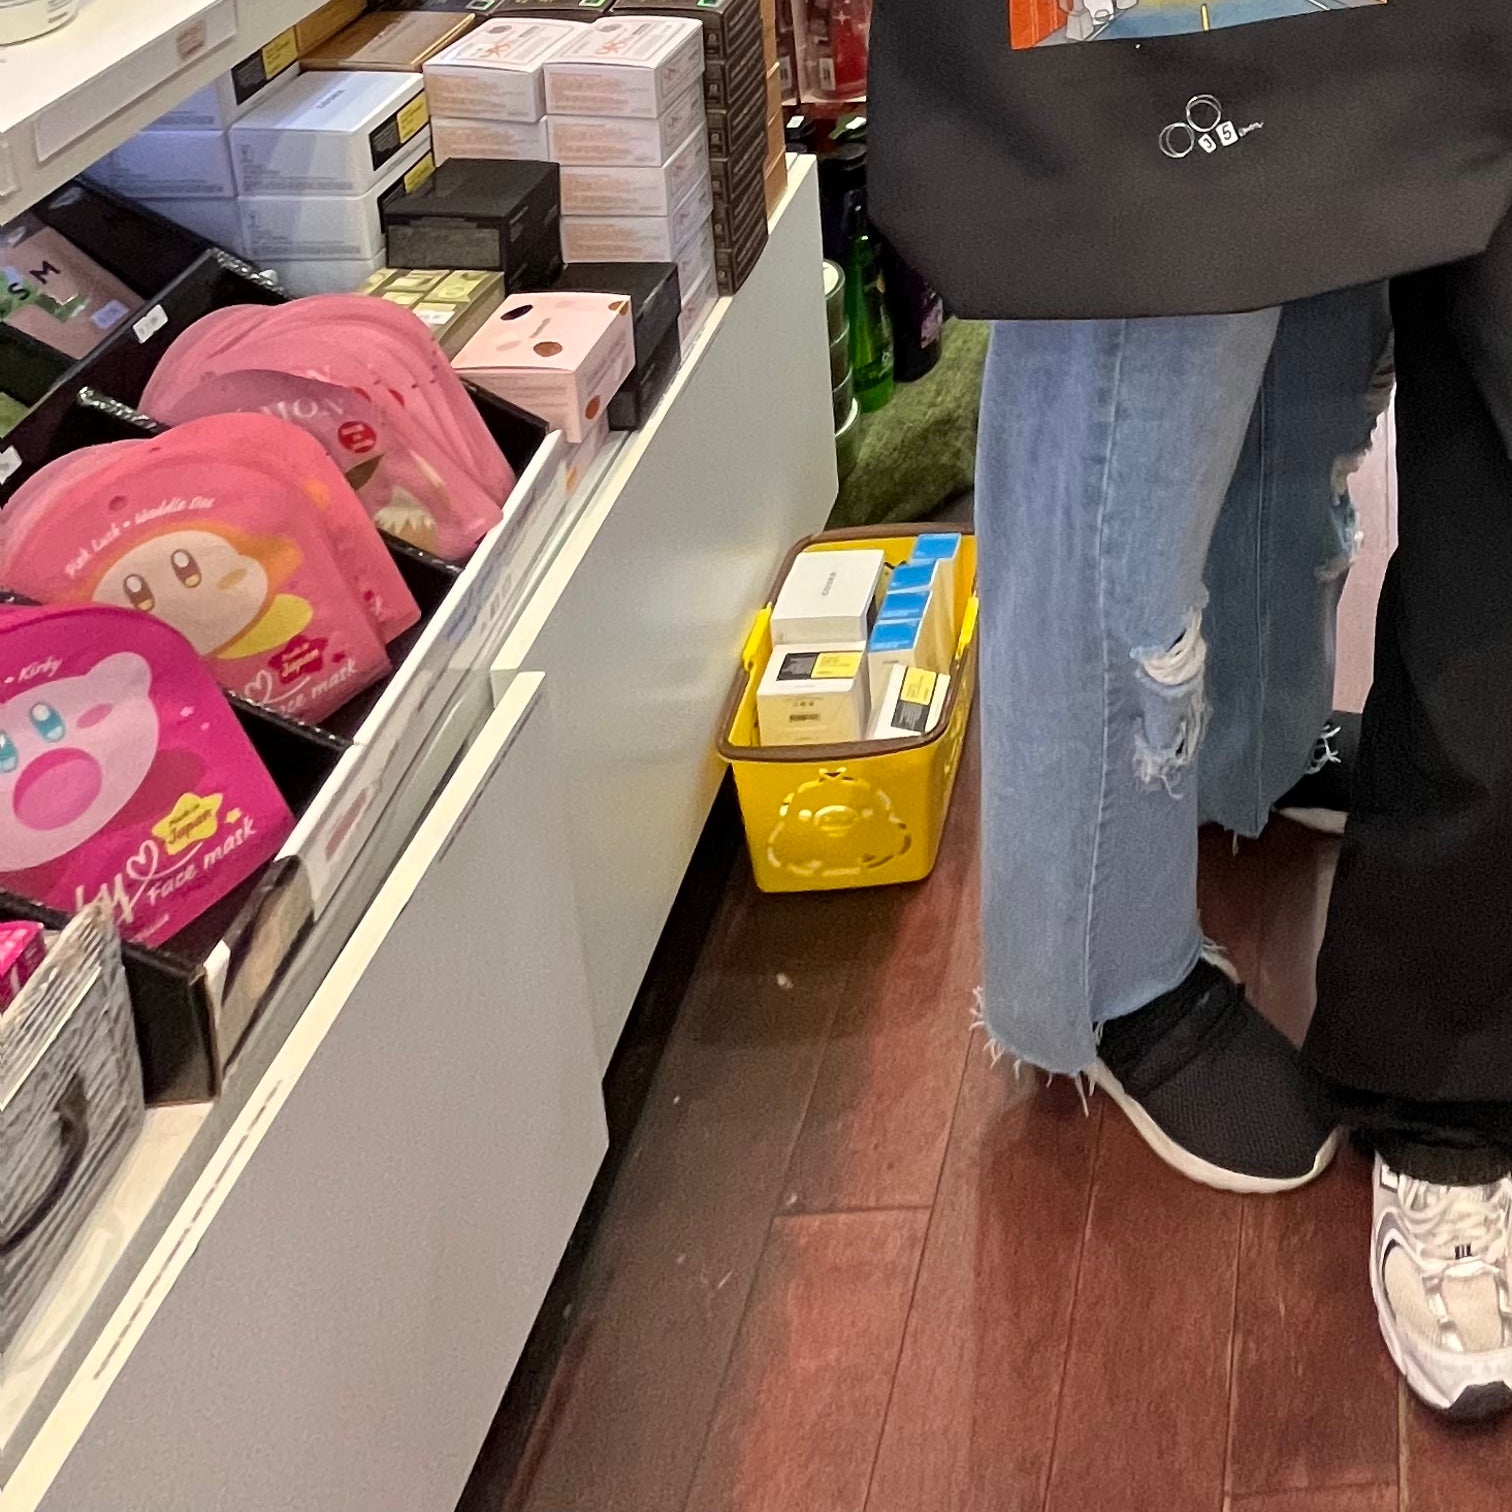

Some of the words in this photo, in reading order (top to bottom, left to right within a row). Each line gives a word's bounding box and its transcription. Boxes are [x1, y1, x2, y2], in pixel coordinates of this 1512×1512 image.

[18, 655, 62, 684] Kirby
[147, 864, 198, 907] Face
[202, 815, 257, 871] mask
